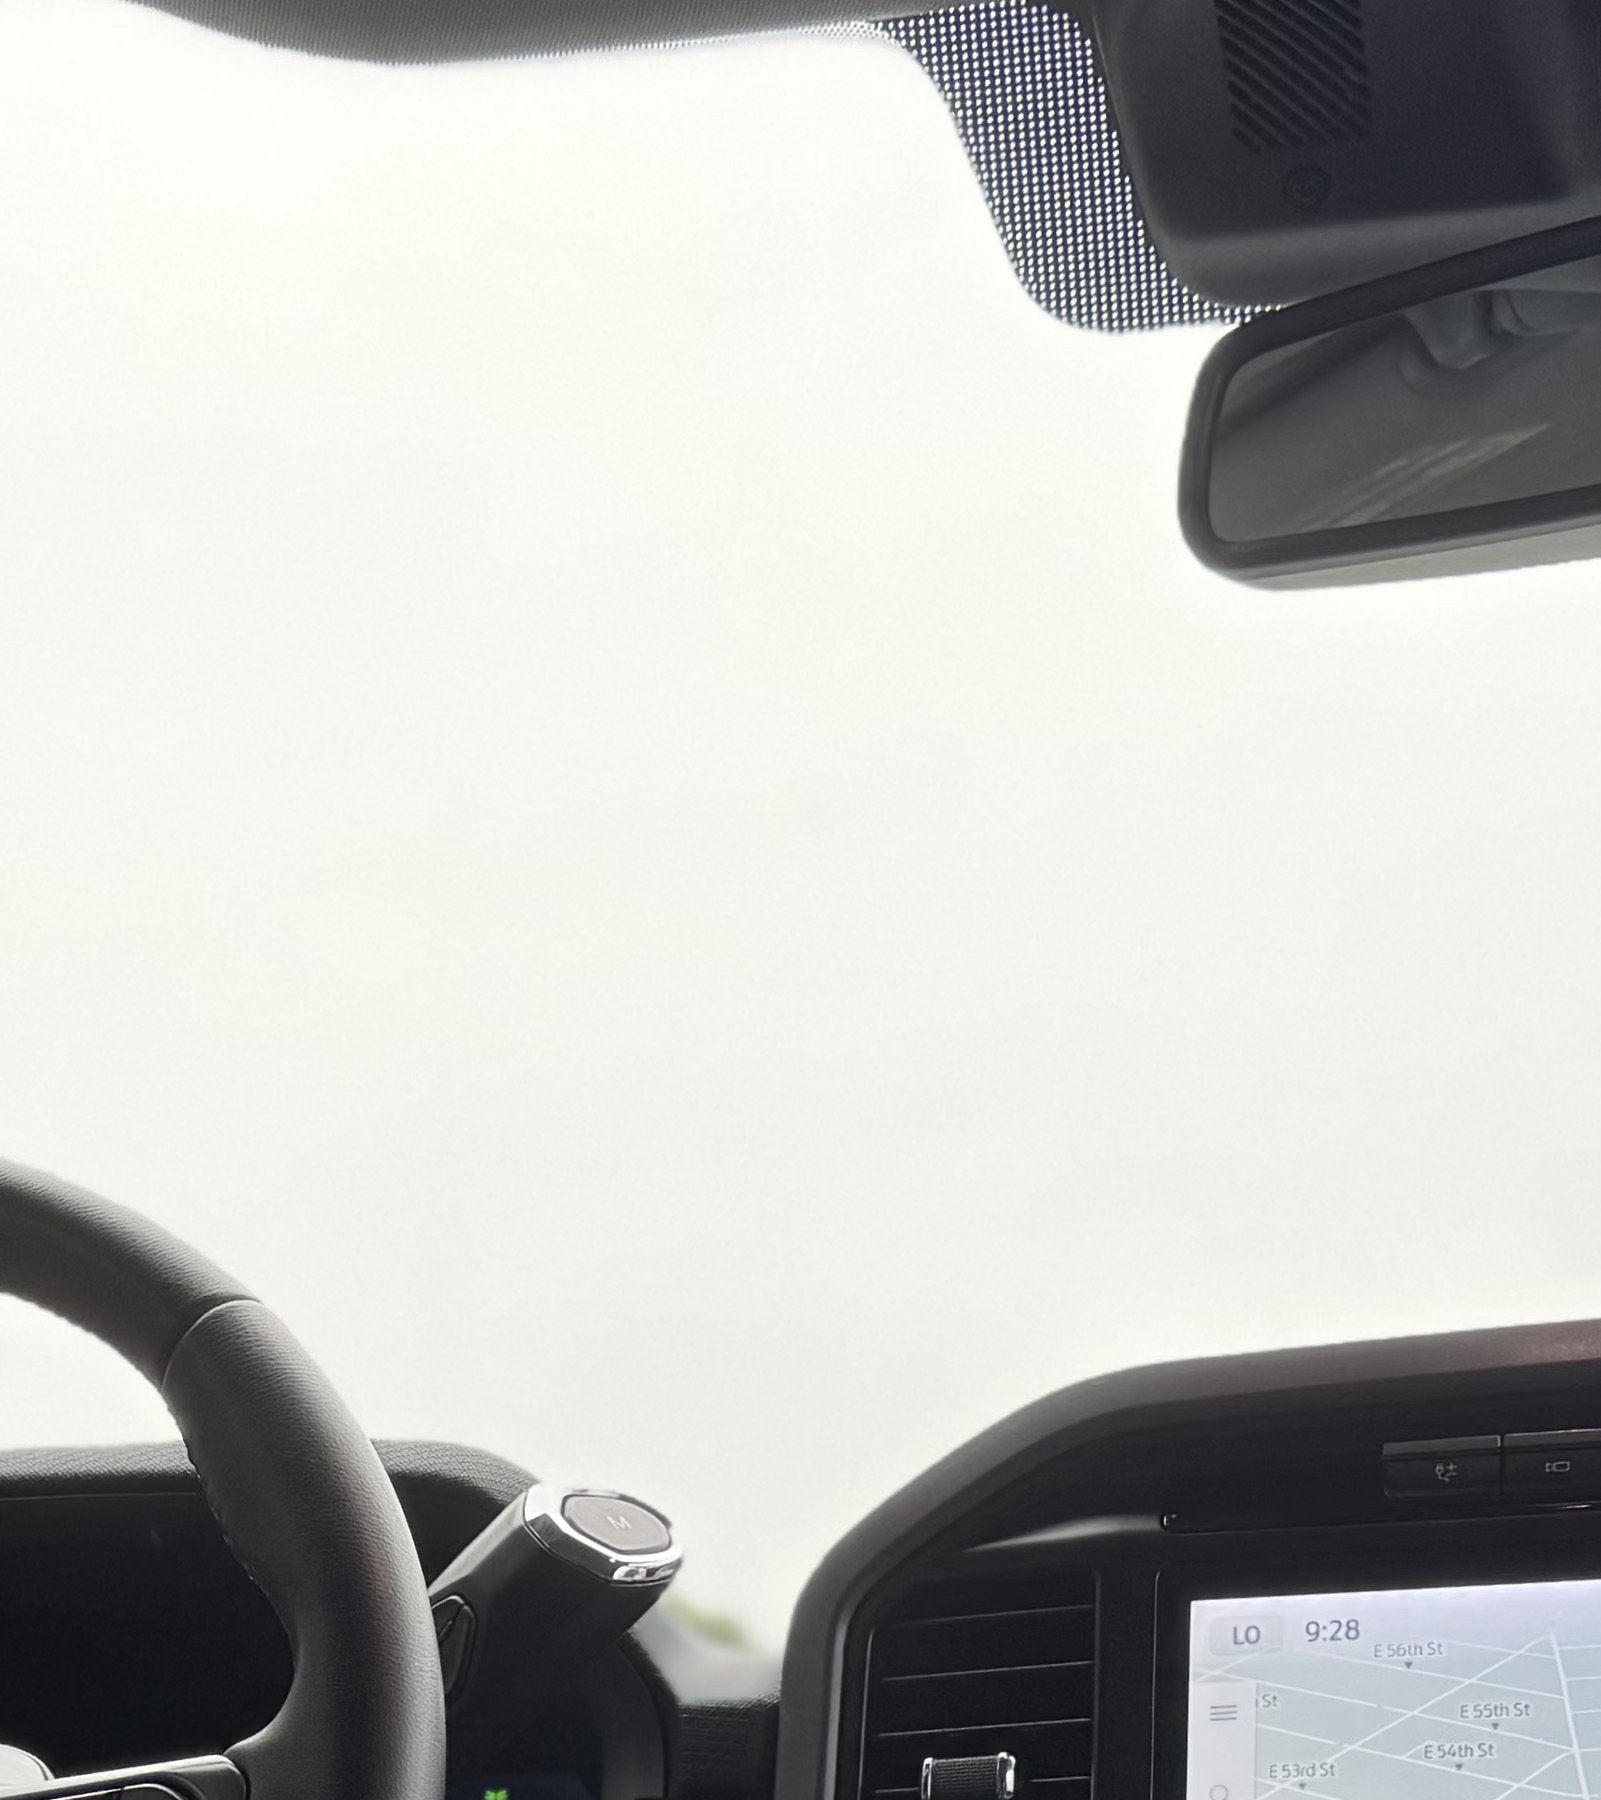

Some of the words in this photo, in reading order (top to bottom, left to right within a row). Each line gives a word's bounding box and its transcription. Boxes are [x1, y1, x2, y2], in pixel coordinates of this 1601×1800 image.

[1232, 1625, 1261, 1645] LO
[1305, 1619, 1360, 1642] 9:28
[1374, 1645, 1381, 1657] E
[1383, 1642, 1423, 1657] 56th
[1425, 1642, 1443, 1656] St
[1262, 1694, 1277, 1708] St
[1460, 1705, 1468, 1718] E
[1473, 1704, 1509, 1718] 55th
[1512, 1703, 1530, 1718] St
[1424, 1746, 1433, 1758] E
[1438, 1744, 1473, 1758] 54th
[1477, 1743, 1494, 1757] St
[1269, 1765, 1278, 1778] E
[1282, 1764, 1315, 1778] 53rd
[1320, 1763, 1335, 1777] St
